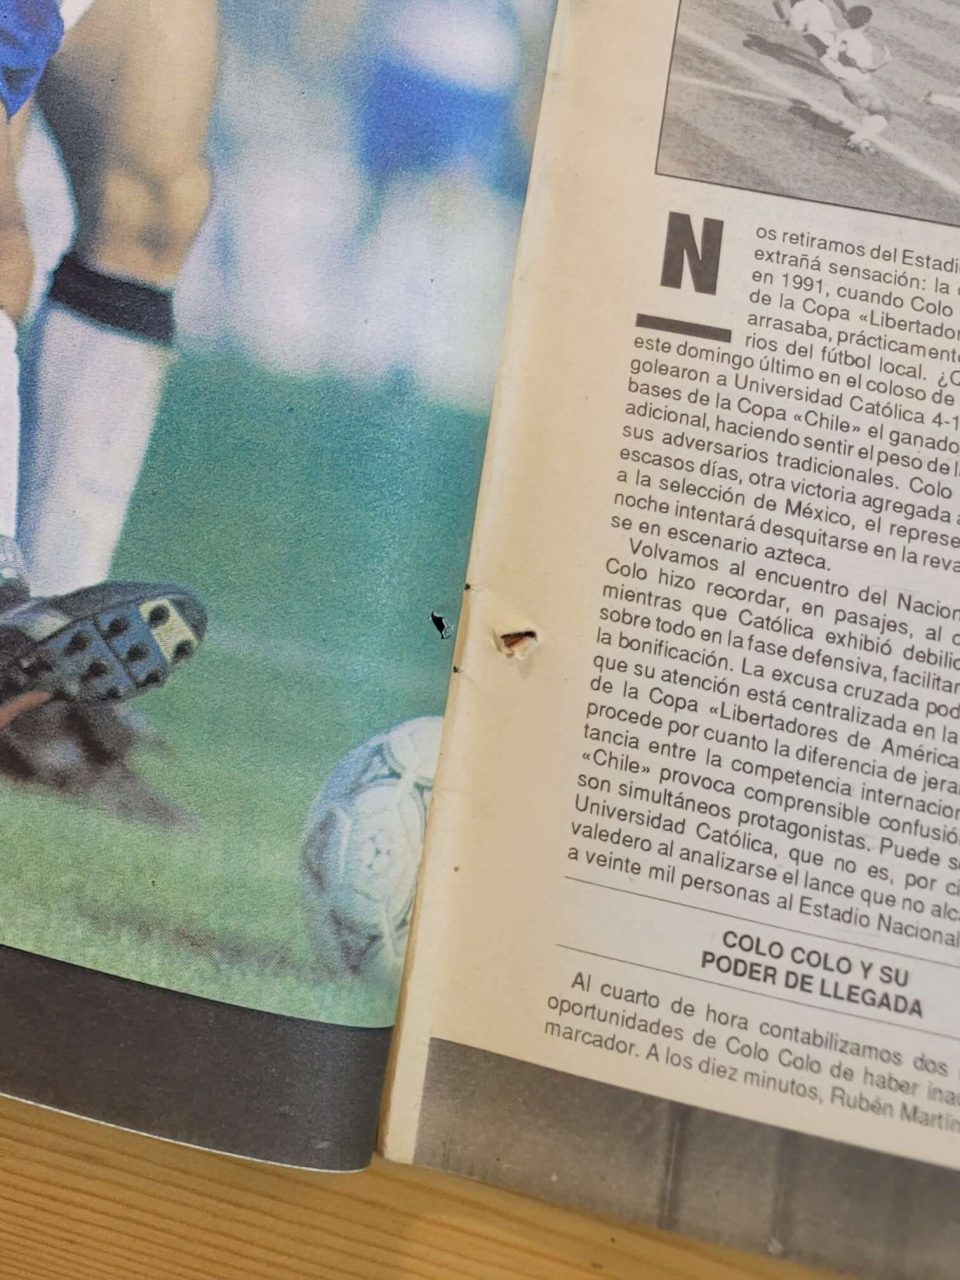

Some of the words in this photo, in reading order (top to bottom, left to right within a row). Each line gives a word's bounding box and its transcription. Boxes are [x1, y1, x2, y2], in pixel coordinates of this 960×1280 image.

[660, 211, 724, 296] N
[781, 231, 865, 256] retiramos
[828, 262, 926, 290] sensación:
[782, 272, 829, 297] 1991,
[836, 286, 903, 308] cuando
[802, 297, 850, 321] Copa
[745, 332, 777, 352] rios
[820, 345, 871, 370] fútbol
[879, 356, 926, 380] local.
[747, 313, 832, 342] arrasaba,
[630, 358, 709, 383] golearon
[734, 372, 842, 408] Universidad
[849, 395, 924, 424] Católica
[633, 336, 671, 353] este
[676, 340, 754, 370] domingo
[759, 355, 814, 380] último
[865, 379, 926, 401] coloso
[625, 400, 709, 432] adicional,
[714, 414, 799, 446] haciendo
[802, 436, 854, 456] sentir
[876, 450, 922, 469] peso
[627, 376, 681, 400] bases
[736, 396, 786, 421] Copa
[793, 409, 860, 432] «Chile»
[619, 447, 694, 472] escasos
[699, 459, 742, 485] días,
[790, 478, 856, 504] victoria
[861, 494, 951, 524] agregada
[622, 425, 653, 441] sus
[661, 431, 768, 463] adversarios
[776, 451, 899, 489] tradicionales.
[908, 476, 952, 499] Colo
[614, 492, 669, 513] noche
[674, 499, 755, 531] intentará
[759, 518, 868, 553] desquitarse
[658, 477, 745, 505] selección
[784, 497, 855, 530] México,
[629, 537, 719, 571] Volvamos
[754, 567, 849, 597] encuentro
[667, 526, 757, 555] escenario
[764, 546, 830, 571] azteca.
[602, 583, 681, 612] mientras
[738, 608, 813, 640] Católica
[825, 630, 892, 655] exhibió
[605, 557, 647, 580] Colo
[658, 567, 695, 590] hizo
[706, 581, 789, 613] recordar,
[834, 608, 912, 639] pasajes,
[599, 607, 651, 628] sobre
[655, 616, 695, 638] todo
[747, 633, 787, 658] fase
[791, 644, 887, 682] defensiva,
[618, 631, 733, 671] bonificación.
[771, 668, 837, 694] excusa
[843, 683, 919, 711] cruzada
[648, 686, 698, 713] Copa
[708, 700, 837, 742] «Libertadores
[660, 668, 739, 697] atención
[746, 687, 786, 707] está
[791, 697, 906, 733] centralizada
[583, 722, 639, 750] tancia
[648, 740, 696, 761] entre
[730, 758, 851, 797] competencia
[586, 702, 663, 729] procede
[703, 727, 768, 752] cuanto
[795, 744, 887, 779] diferencia
[581, 748, 650, 773] «Chile»
[658, 767, 735, 795] provoca
[743, 786, 870, 825] comprensible
[574, 793, 686, 834] Universidad
[695, 821, 777, 859] Católica,
[617, 780, 731, 819] simultáneos
[737, 810, 870, 851] protagonistas.
[879, 836, 940, 866] Puede
[571, 821, 652, 852] valedero
[679, 847, 777, 880] analizarse
[803, 870, 854, 898] lance
[585, 850, 641, 875] veinte
[648, 864, 675, 883] mil
[680, 873, 769, 905] personas
[798, 895, 870, 927] Estadio
[700, 950, 777, 985] PODER
[783, 969, 814, 993] DE
[819, 977, 923, 1018] LLEGADA
[722, 930, 784, 959] COLO
[790, 946, 852, 974] COLO
[860, 960, 873, 979] Y
[878, 965, 908, 987] SU
[547, 995, 683, 1040] oportunidades
[725, 1035, 769, 1061] Colo
[777, 1048, 821, 1073] Colo
[863, 1066, 917, 1094] haber
[600, 983, 659, 1008] cuarto
[705, 1003, 748, 1030] hora
[759, 1021, 901, 1065] contabilizamos
[913, 1053, 947, 1076] dos
[544, 1021, 639, 1057] marcador.
[697, 1055, 738, 1081] diez
[743, 1069, 823, 1104] minutos,
[829, 1085, 894, 1117] Rubén
